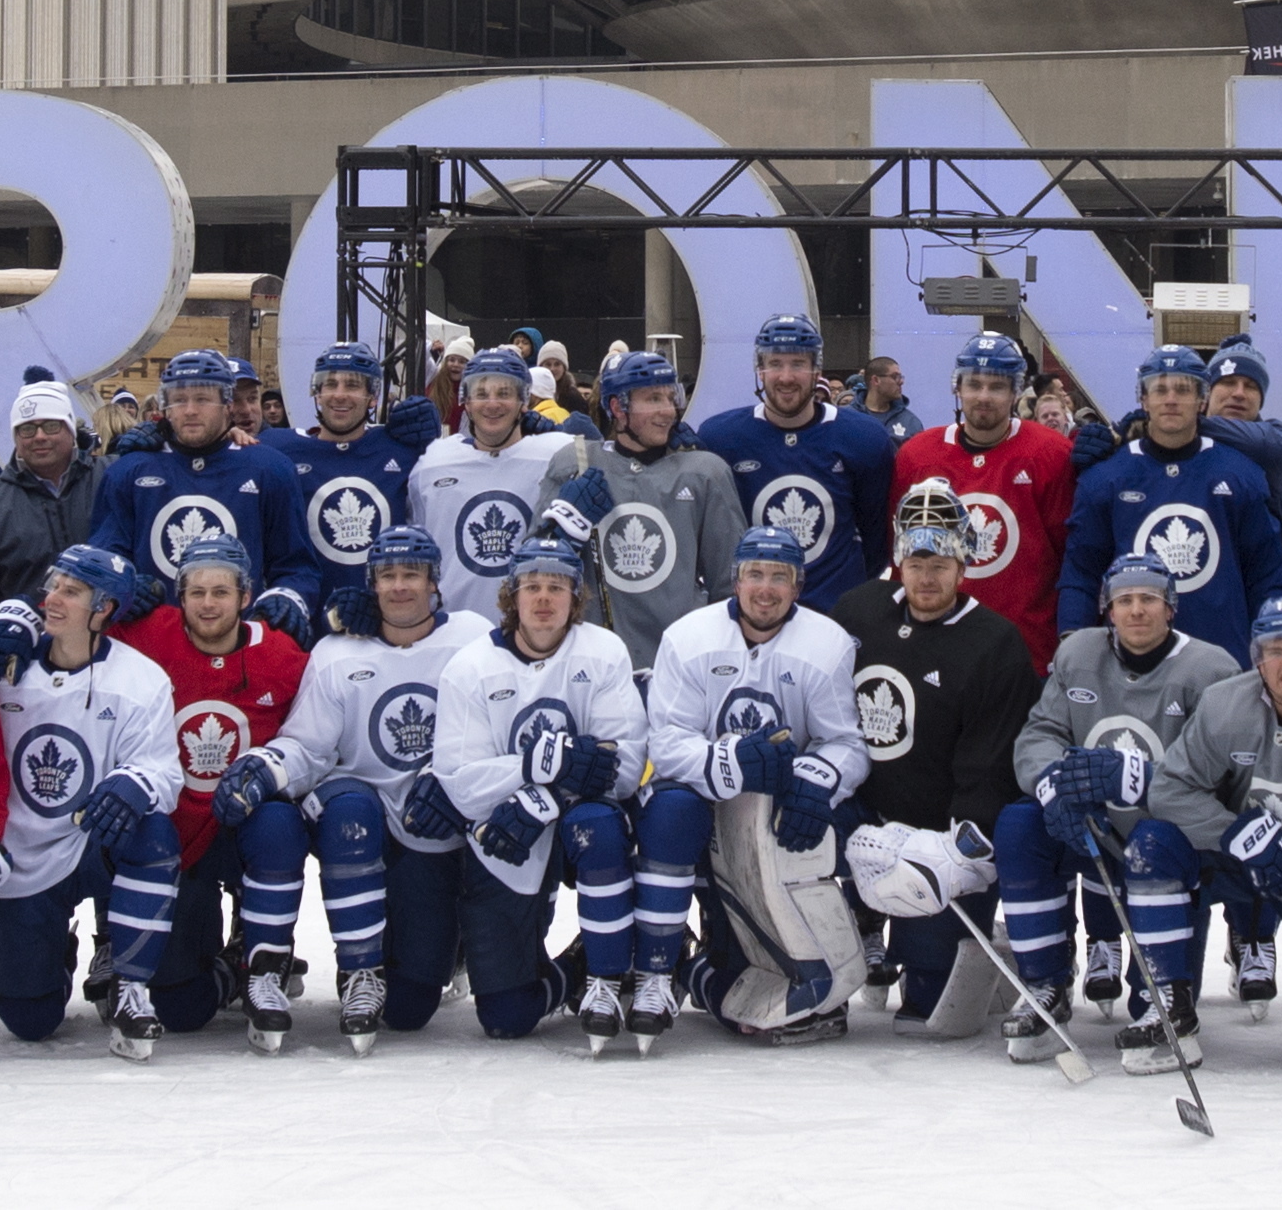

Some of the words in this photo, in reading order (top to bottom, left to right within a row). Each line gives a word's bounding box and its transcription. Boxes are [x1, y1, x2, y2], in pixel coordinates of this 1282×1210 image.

[979, 340, 996, 349] 92
[336, 517, 367, 527] TORONTO
[778, 517, 811, 526] TORONTO
[477, 530, 512, 539] TORONTO
[483, 544, 506, 552] LEAFS
[618, 544, 651, 554] TORONTO
[1162, 543, 1196, 553] TORONTO
[866, 708, 897, 723] TORONTO
[869, 717, 892, 727] MAPLE
[396, 725, 431, 736] TORONTO
[867, 724, 890, 734] LEAFS
[402, 733, 424, 741] MAPLE
[193, 744, 227, 753] TORONTO
[402, 740, 426, 748] LEAFS
[35, 768, 67, 779] TORONTO
[1243, 813, 1279, 854] BAU
